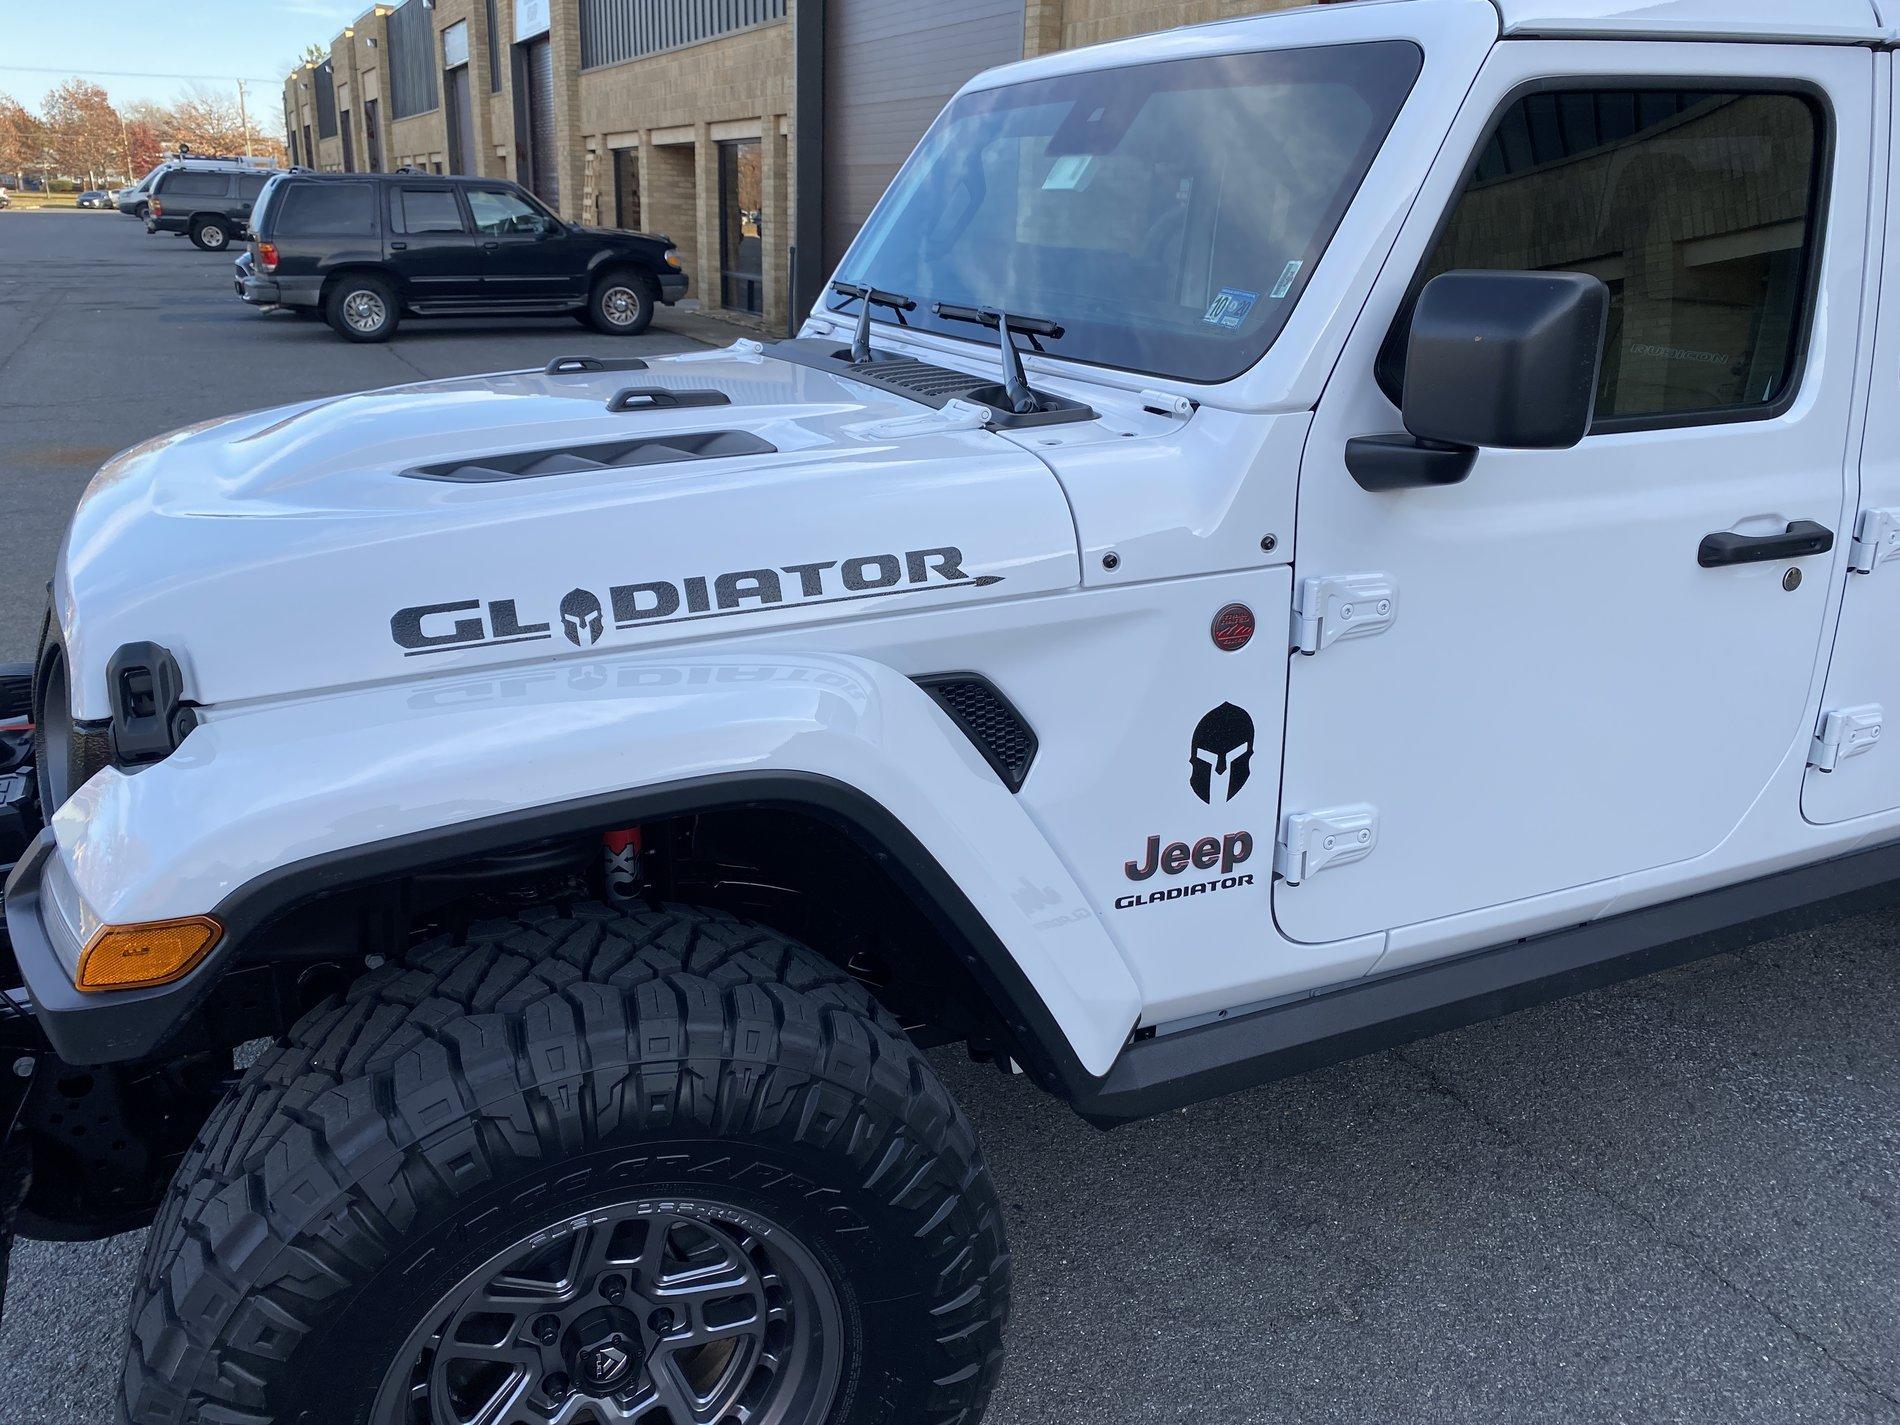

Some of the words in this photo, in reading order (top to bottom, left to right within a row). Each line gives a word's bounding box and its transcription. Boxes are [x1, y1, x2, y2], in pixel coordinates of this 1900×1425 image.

[1630, 343, 1729, 365] RUBICON
[390, 546, 970, 650] GLDIATOR
[1125, 830, 1254, 881] Jeep
[1115, 873, 1255, 910] GLADIATOR
[529, 1215, 608, 1249] FUEL
[635, 1201, 773, 1237] OFF-ROAD
